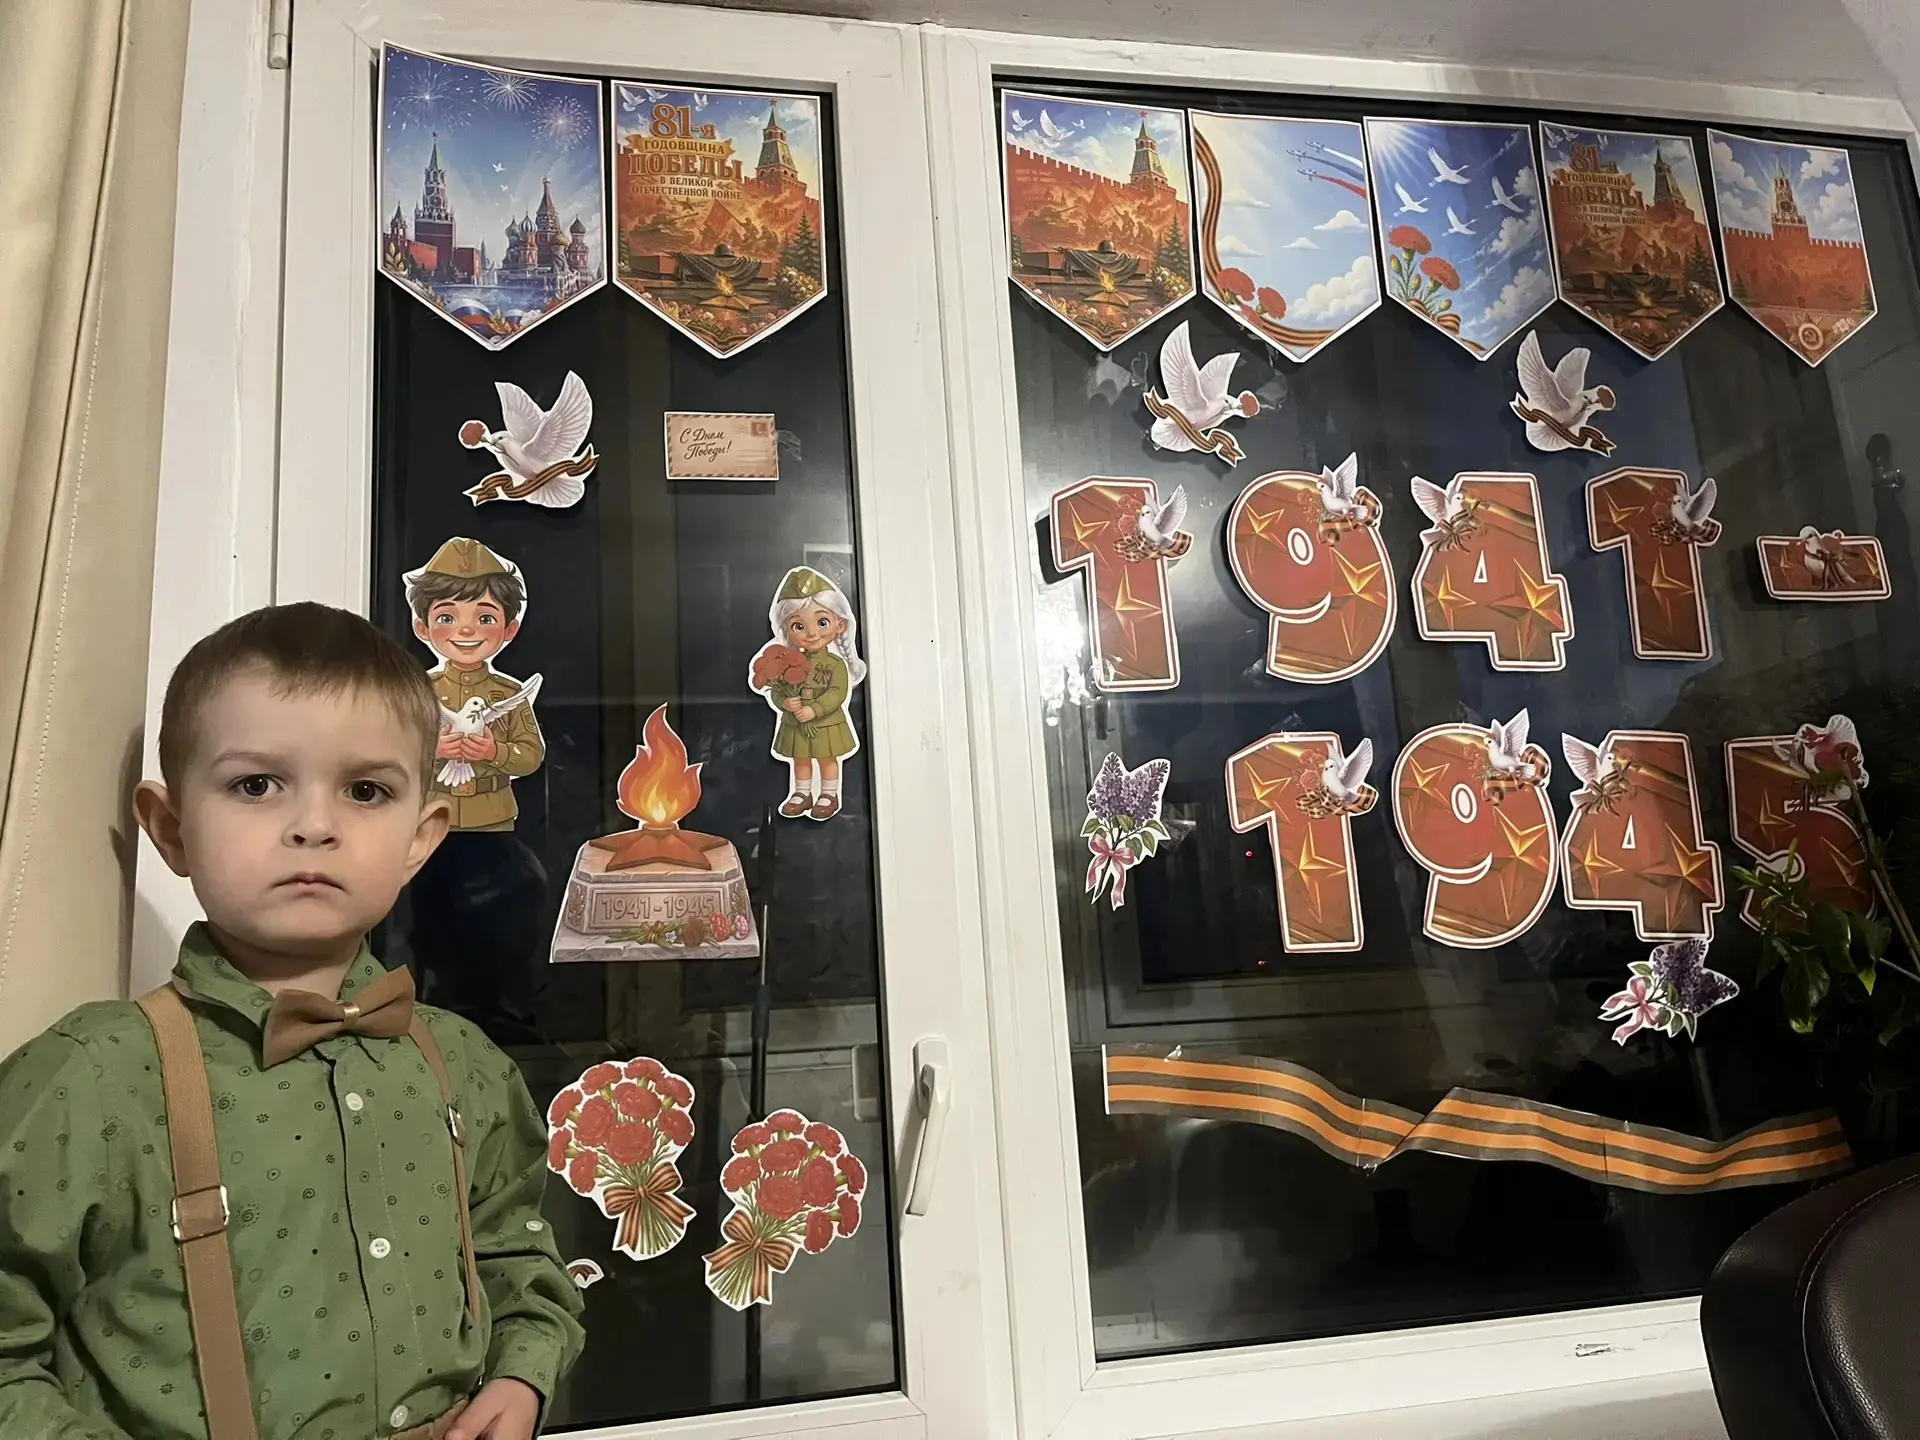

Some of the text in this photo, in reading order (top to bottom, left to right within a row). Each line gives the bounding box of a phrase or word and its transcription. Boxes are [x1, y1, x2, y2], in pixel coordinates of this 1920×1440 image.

[651, 104, 717, 140] 81-я
[643, 139, 724, 155] ГОДОВЩИНА
[629, 152, 743, 183] ПОБЕДЫ
[660, 176, 714, 188] В ВЕЛИКОЙ
[1567, 173, 1627, 187] ГОДОВЩИНА
[632, 184, 742, 200] ОТЕЧЕСТВЕННОЙ ВОЙНЕ
[1559, 185, 1646, 210] ПОБЕДЫ
[679, 427, 725, 444] С Днем
[684, 440, 732, 463] Победы!
[1225, 722, 1878, 954] 1945
